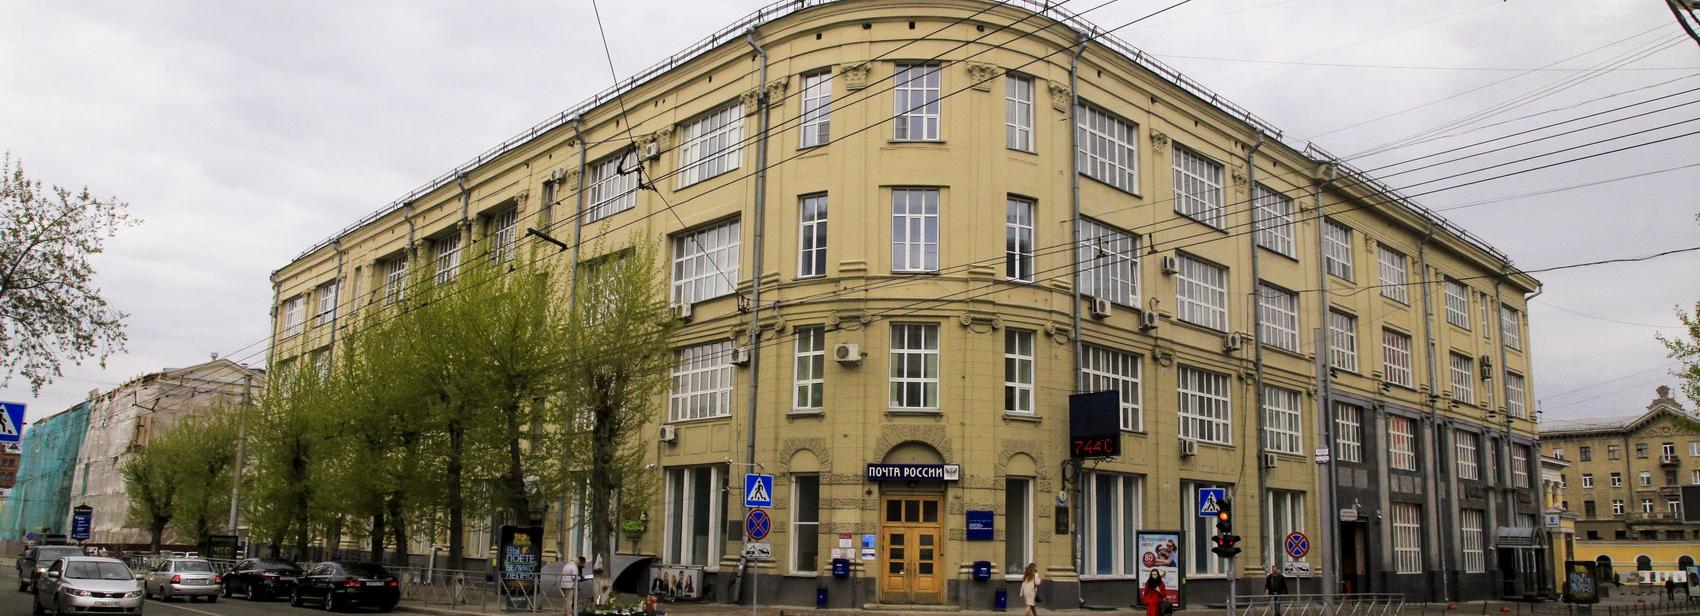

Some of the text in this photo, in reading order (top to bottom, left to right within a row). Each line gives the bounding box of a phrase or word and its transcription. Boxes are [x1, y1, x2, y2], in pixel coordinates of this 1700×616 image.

[869, 467, 943, 478] ПОЧТА РОССИИ
[506, 546, 520, 555] ВЫ
[506, 554, 535, 563] ПОЕТЕ
